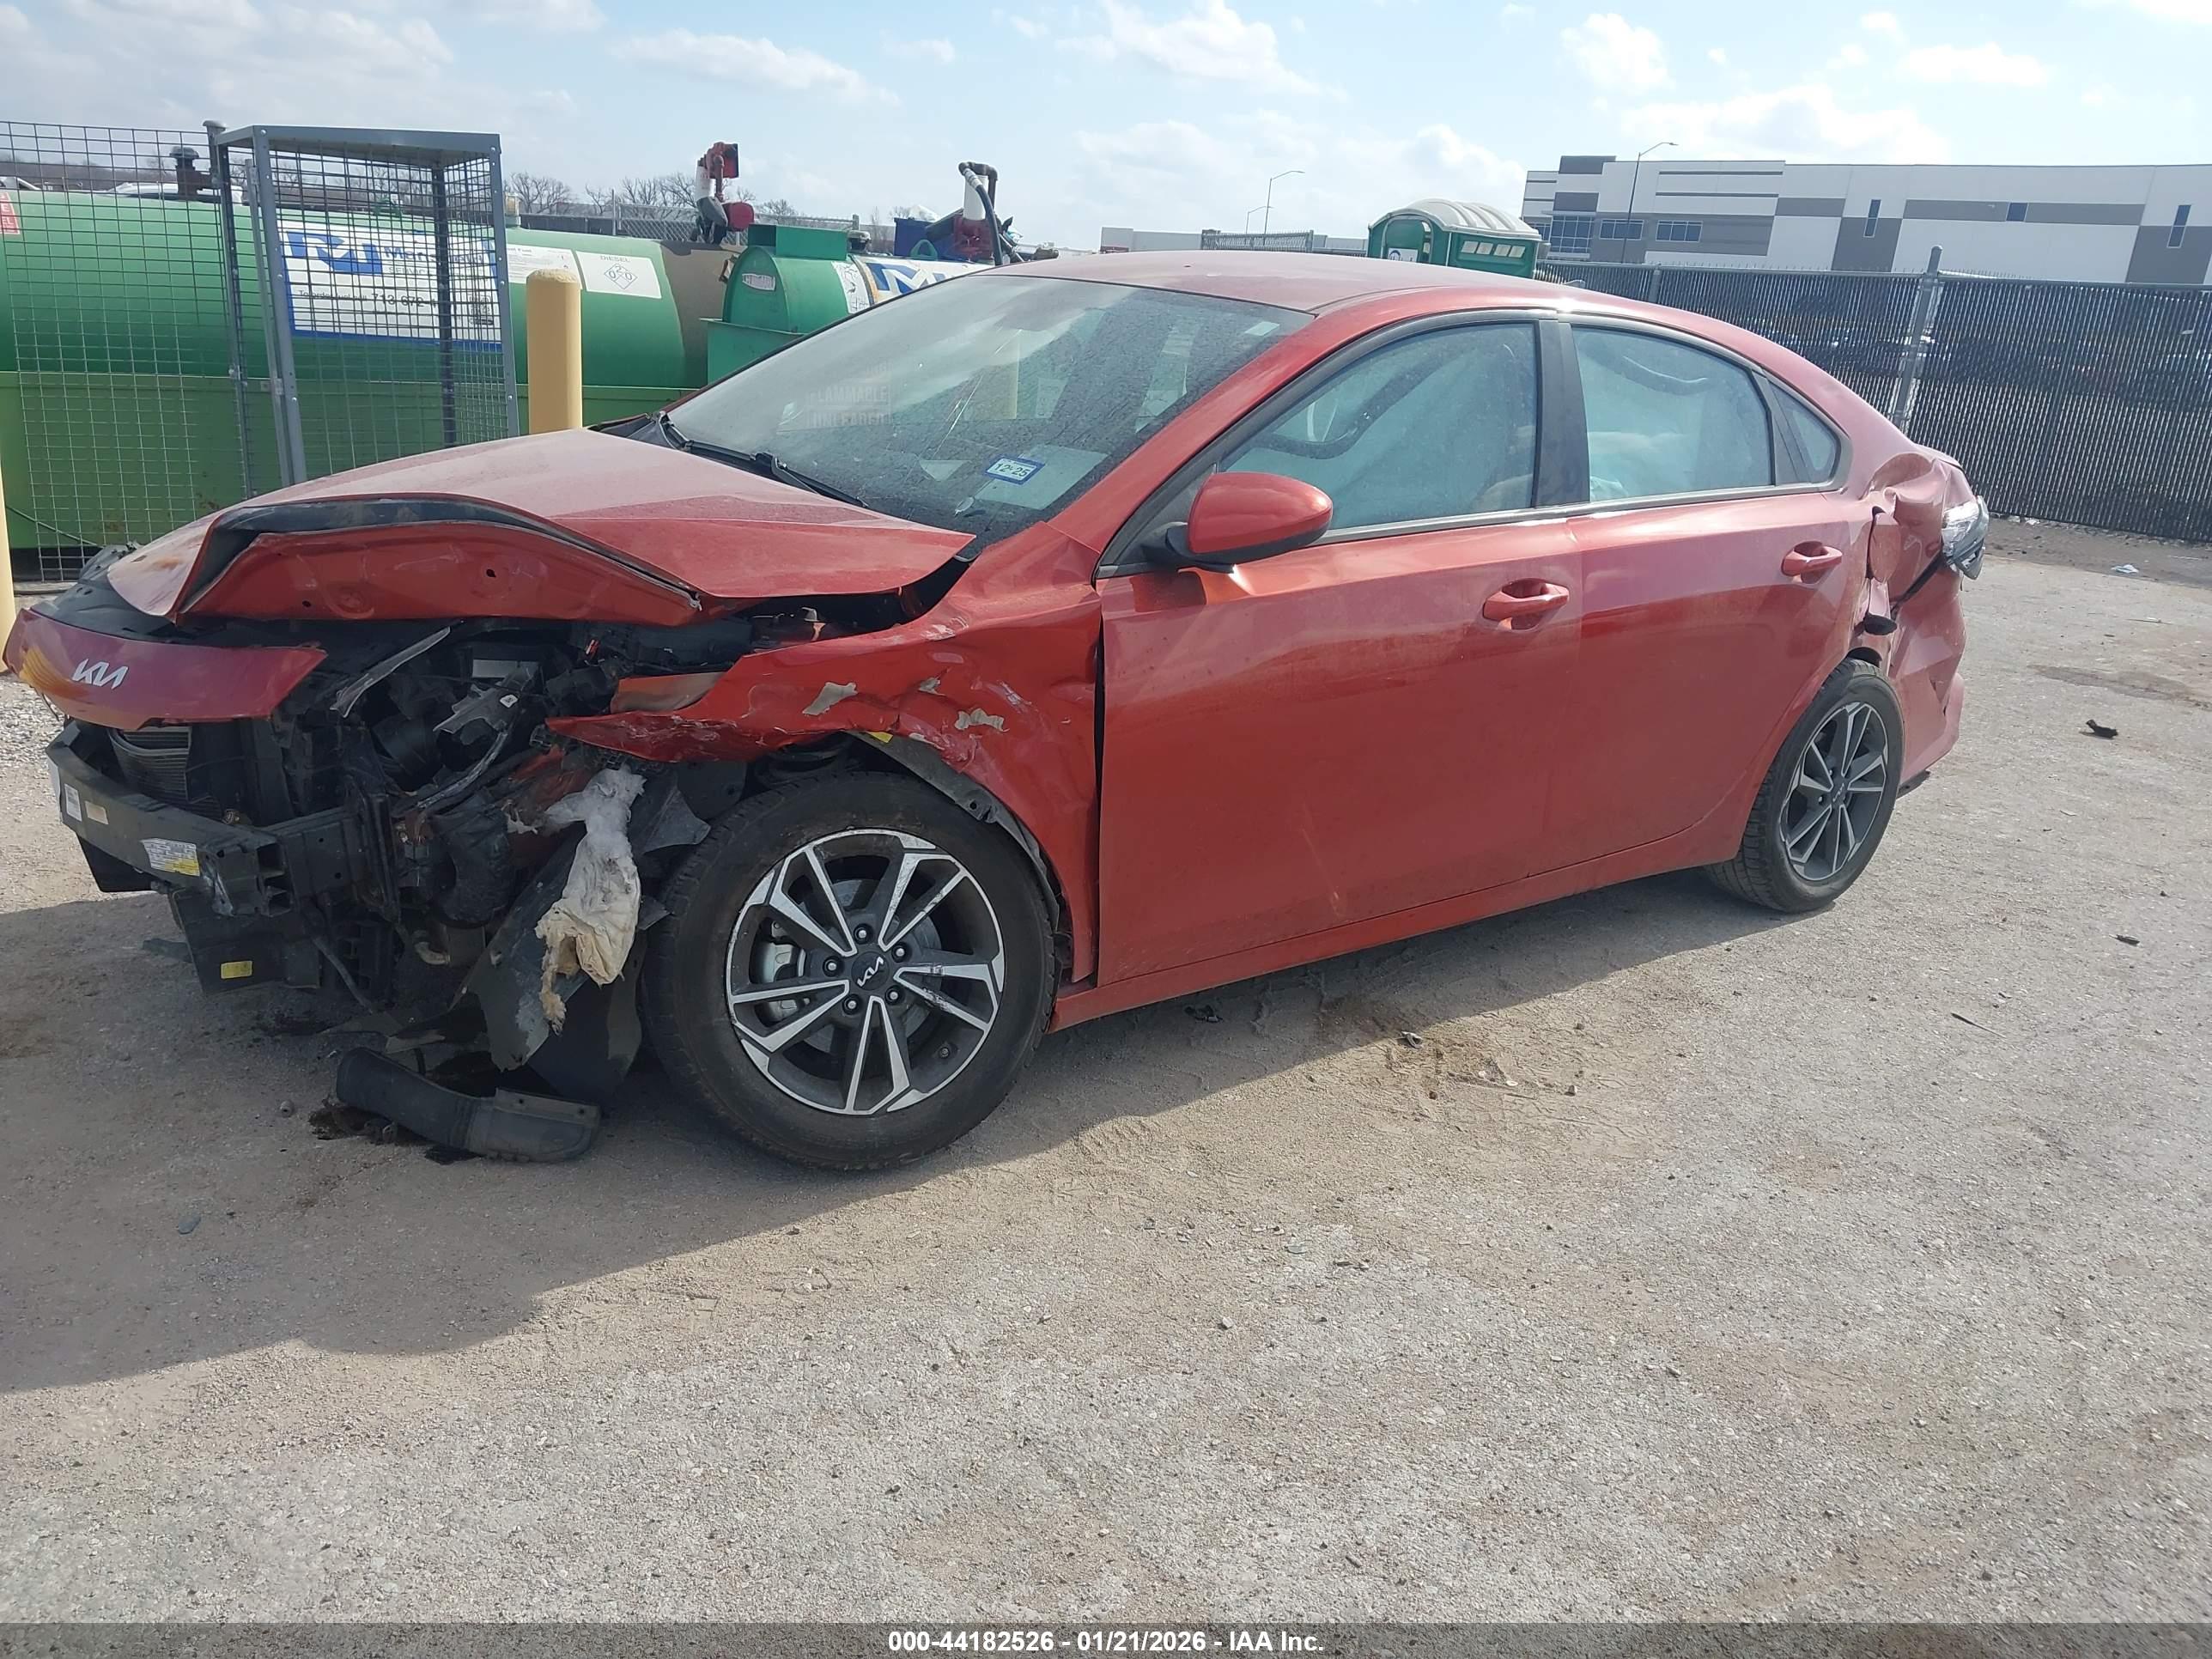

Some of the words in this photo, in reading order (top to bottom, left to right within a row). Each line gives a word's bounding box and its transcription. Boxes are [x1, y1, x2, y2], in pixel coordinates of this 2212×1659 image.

[609, 270, 617, 279] 0
[72, 658, 129, 690] KIA
[857, 956, 884, 987] KIA
